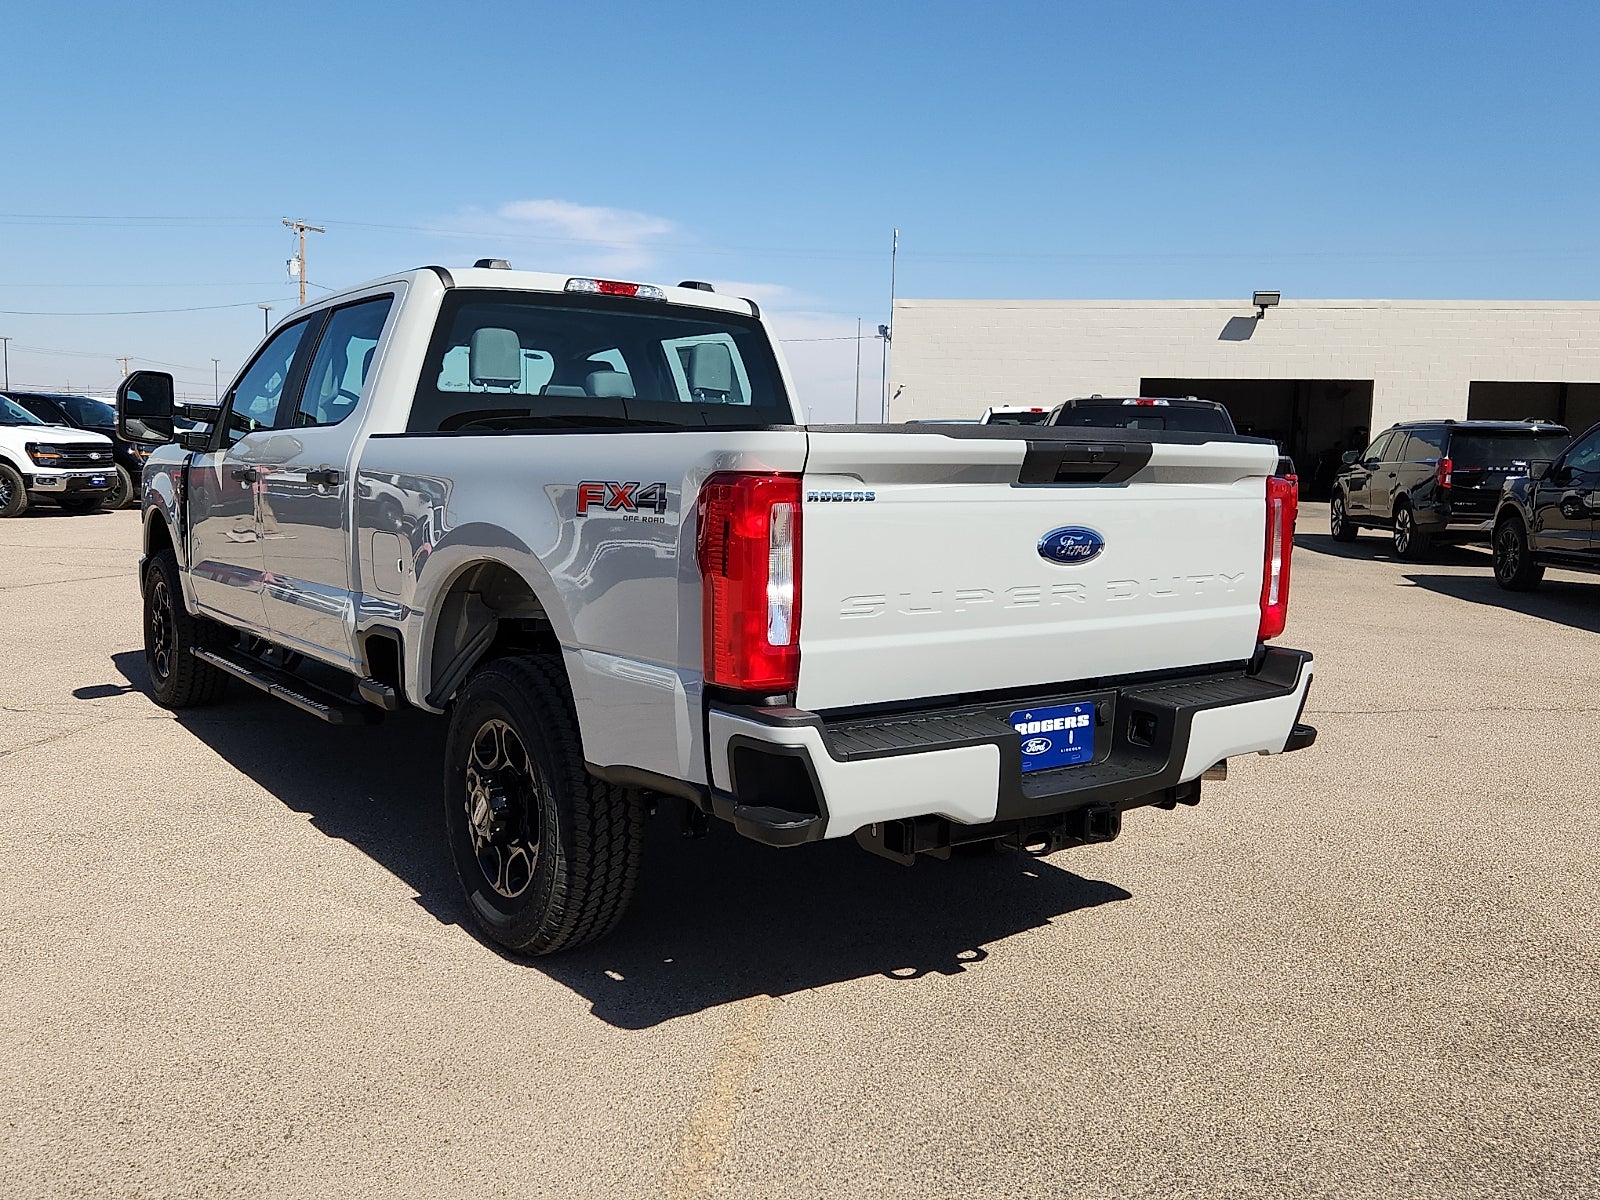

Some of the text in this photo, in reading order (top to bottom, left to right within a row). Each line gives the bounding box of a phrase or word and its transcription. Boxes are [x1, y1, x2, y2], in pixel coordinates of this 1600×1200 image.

[576, 480, 667, 517] FX4
[807, 491, 876, 503] ROGERS
[622, 515, 665, 524] OFF ROAD
[1056, 535, 1093, 557] Ford
[840, 572, 1245, 619] SUPER DUTY
[1014, 714, 1090, 736] ROGERS
[1025, 739, 1047, 753] Ford
